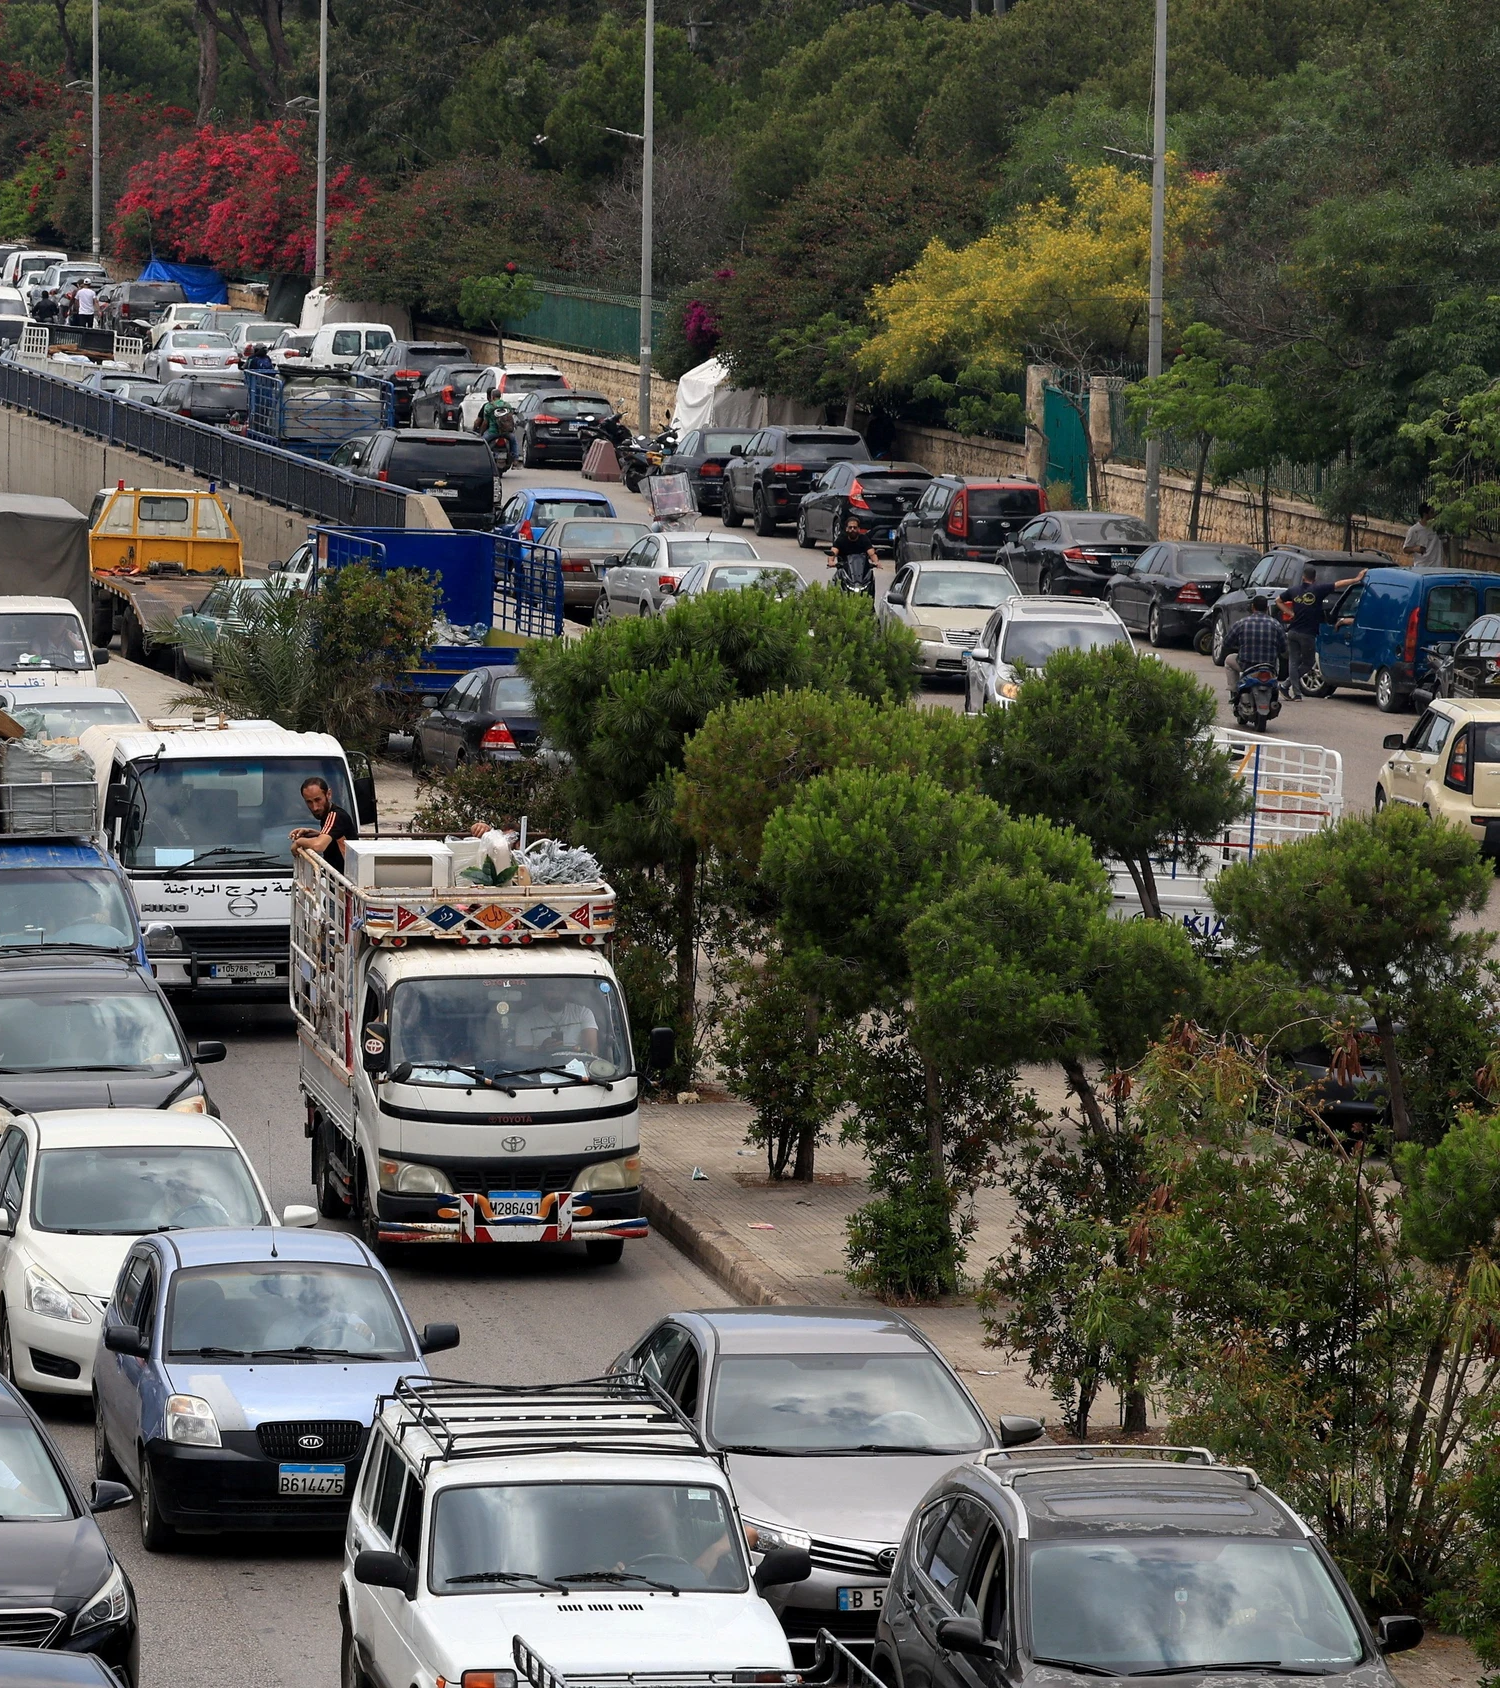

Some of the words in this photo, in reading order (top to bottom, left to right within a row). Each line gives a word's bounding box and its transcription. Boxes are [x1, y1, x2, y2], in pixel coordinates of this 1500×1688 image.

[163, 883, 220, 897] البراجنة
[225, 884, 268, 897] برج
[141, 904, 189, 913] HINO
[1183, 914, 1227, 936] KIA
[222, 965, 249, 973] 105786
[497, 1115, 532, 1123] TOYOTA
[583, 1143, 617, 1151] DYNA
[489, 1201, 540, 1216] M286491
[302, 1438, 320, 1446] KIA
[281, 1477, 344, 1493] B614475
[853, 1590, 863, 1608] B
[873, 1590, 883, 1608] 5
